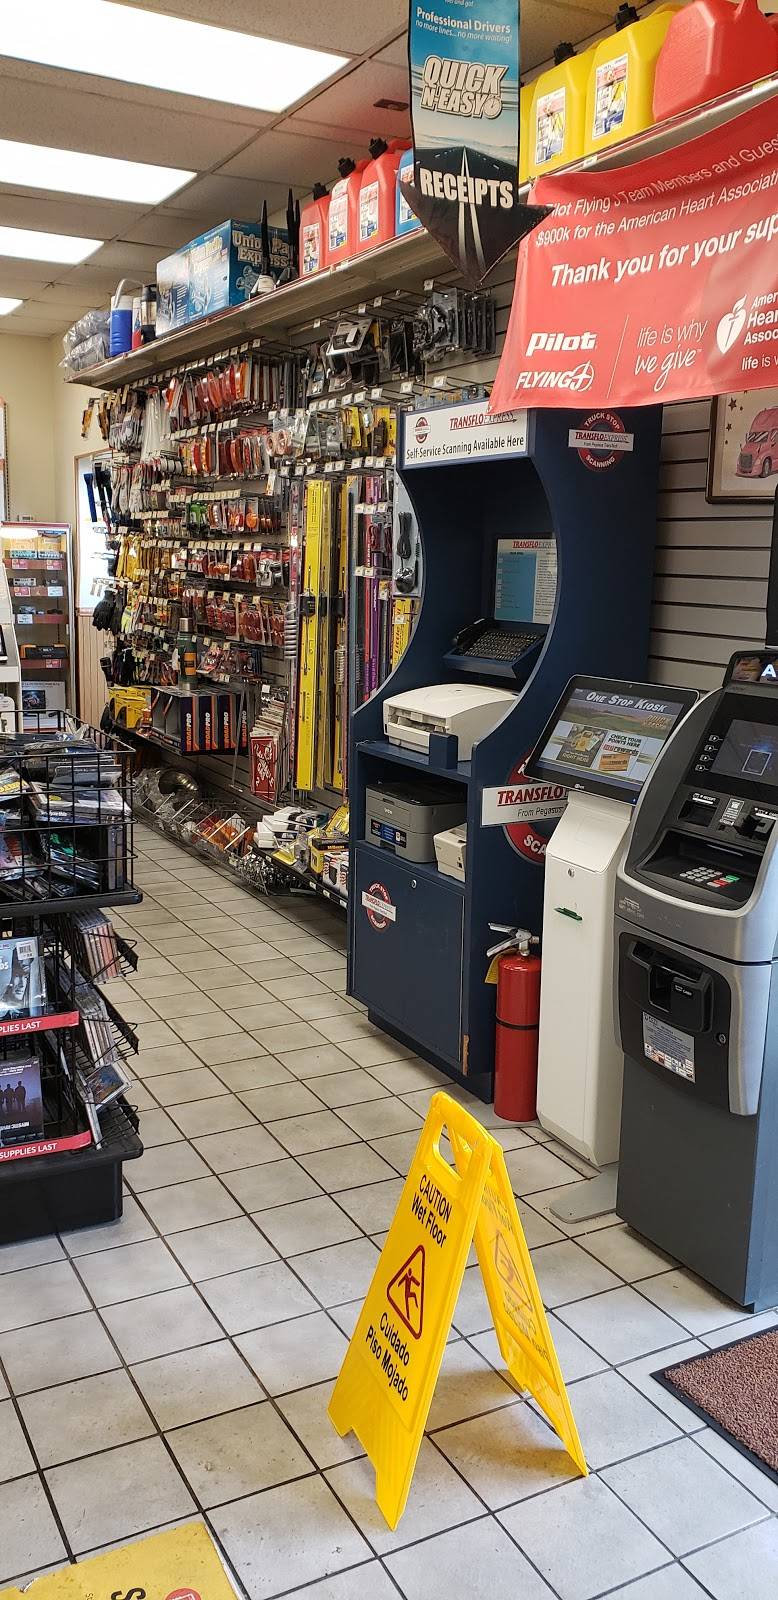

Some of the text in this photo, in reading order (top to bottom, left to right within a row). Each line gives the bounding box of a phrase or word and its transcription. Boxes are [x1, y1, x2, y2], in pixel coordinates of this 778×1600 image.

[416, 6, 511, 34] Professional Drivers
[423, 22, 438, 32] more
[423, 55, 508, 95] QUICK
[420, 168, 514, 208] RECEIPTS
[574, 196, 610, 216] Flying
[618, 186, 654, 204] Team
[656, 166, 712, 194] Members
[712, 155, 740, 174] and
[536, 227, 571, 248] $900k
[573, 225, 592, 239] for
[595, 222, 614, 237] the
[617, 206, 676, 232] American
[678, 190, 715, 216] Heart
[552, 256, 611, 287] Thank
[614, 253, 654, 283] you
[657, 244, 689, 270] for
[691, 230, 742, 266] your
[526, 331, 597, 357] Pilot
[638, 318, 708, 348] life is why
[634, 354, 658, 376] we
[742, 356, 758, 370] life
[762, 354, 770, 368] is
[584, 412, 620, 430] TRUCK STOP
[406, 436, 524, 460] Self-Service Scanning Available Here
[586, 454, 616, 468] SCANNING
[517, 808, 534, 817] From
[22, 1020, 42, 1030] LAST
[38, 1142, 58, 1152] LAST
[420, 1174, 452, 1224] CAUTION
[412, 1192, 446, 1248] Wet Floor
[380, 1312, 410, 1366] Cuidado
[366, 1325, 408, 1402] Piso Mojado
